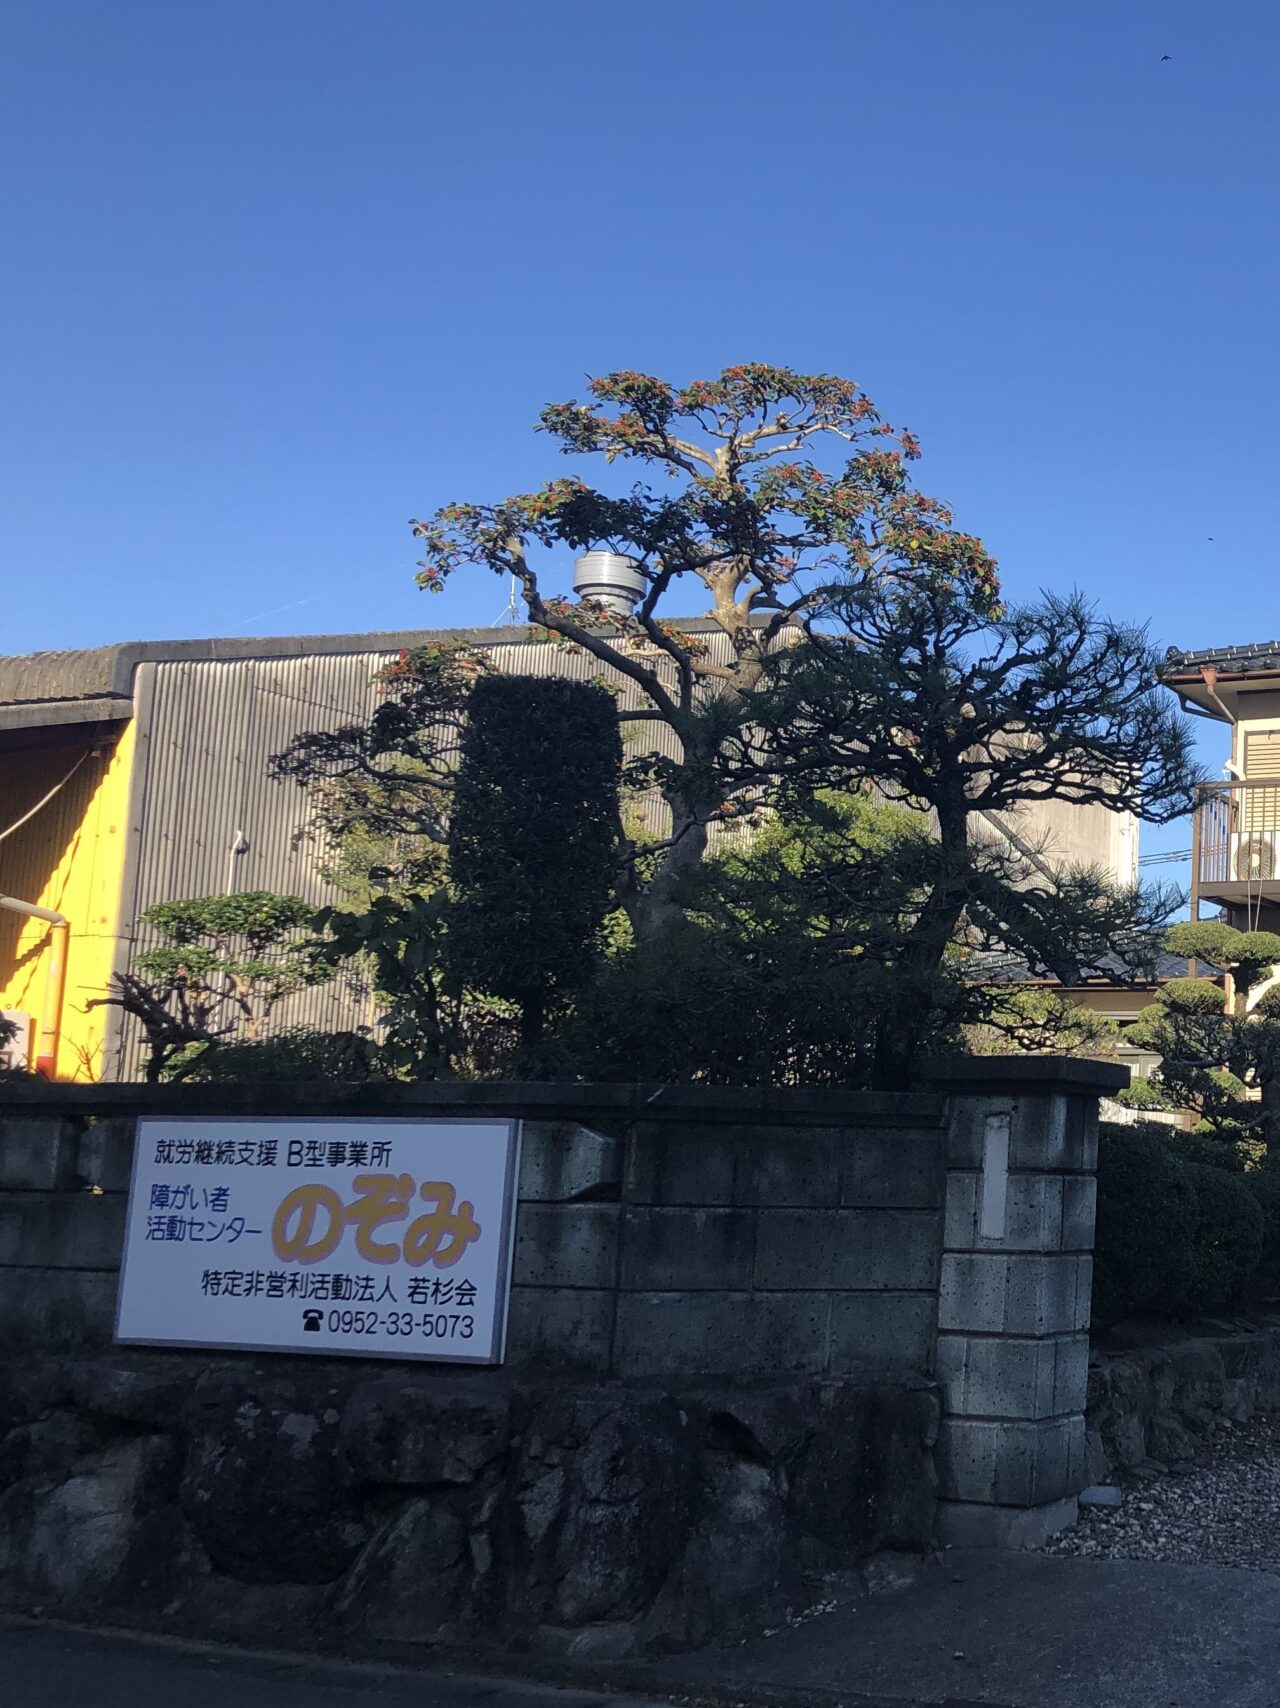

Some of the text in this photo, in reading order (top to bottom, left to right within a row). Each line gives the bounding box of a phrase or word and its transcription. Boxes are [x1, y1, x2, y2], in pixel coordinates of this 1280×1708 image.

[154, 1139, 393, 1168] 就労継続支援 B型事業所
[150, 1184, 230, 1213] 障がい者
[145, 1215, 263, 1243] 活動センター
[271, 1173, 482, 1270] のぞみ
[201, 1269, 478, 1306] 特定非営利活動法人 若杉会
[328, 1309, 474, 1339] 0952-33-5073
